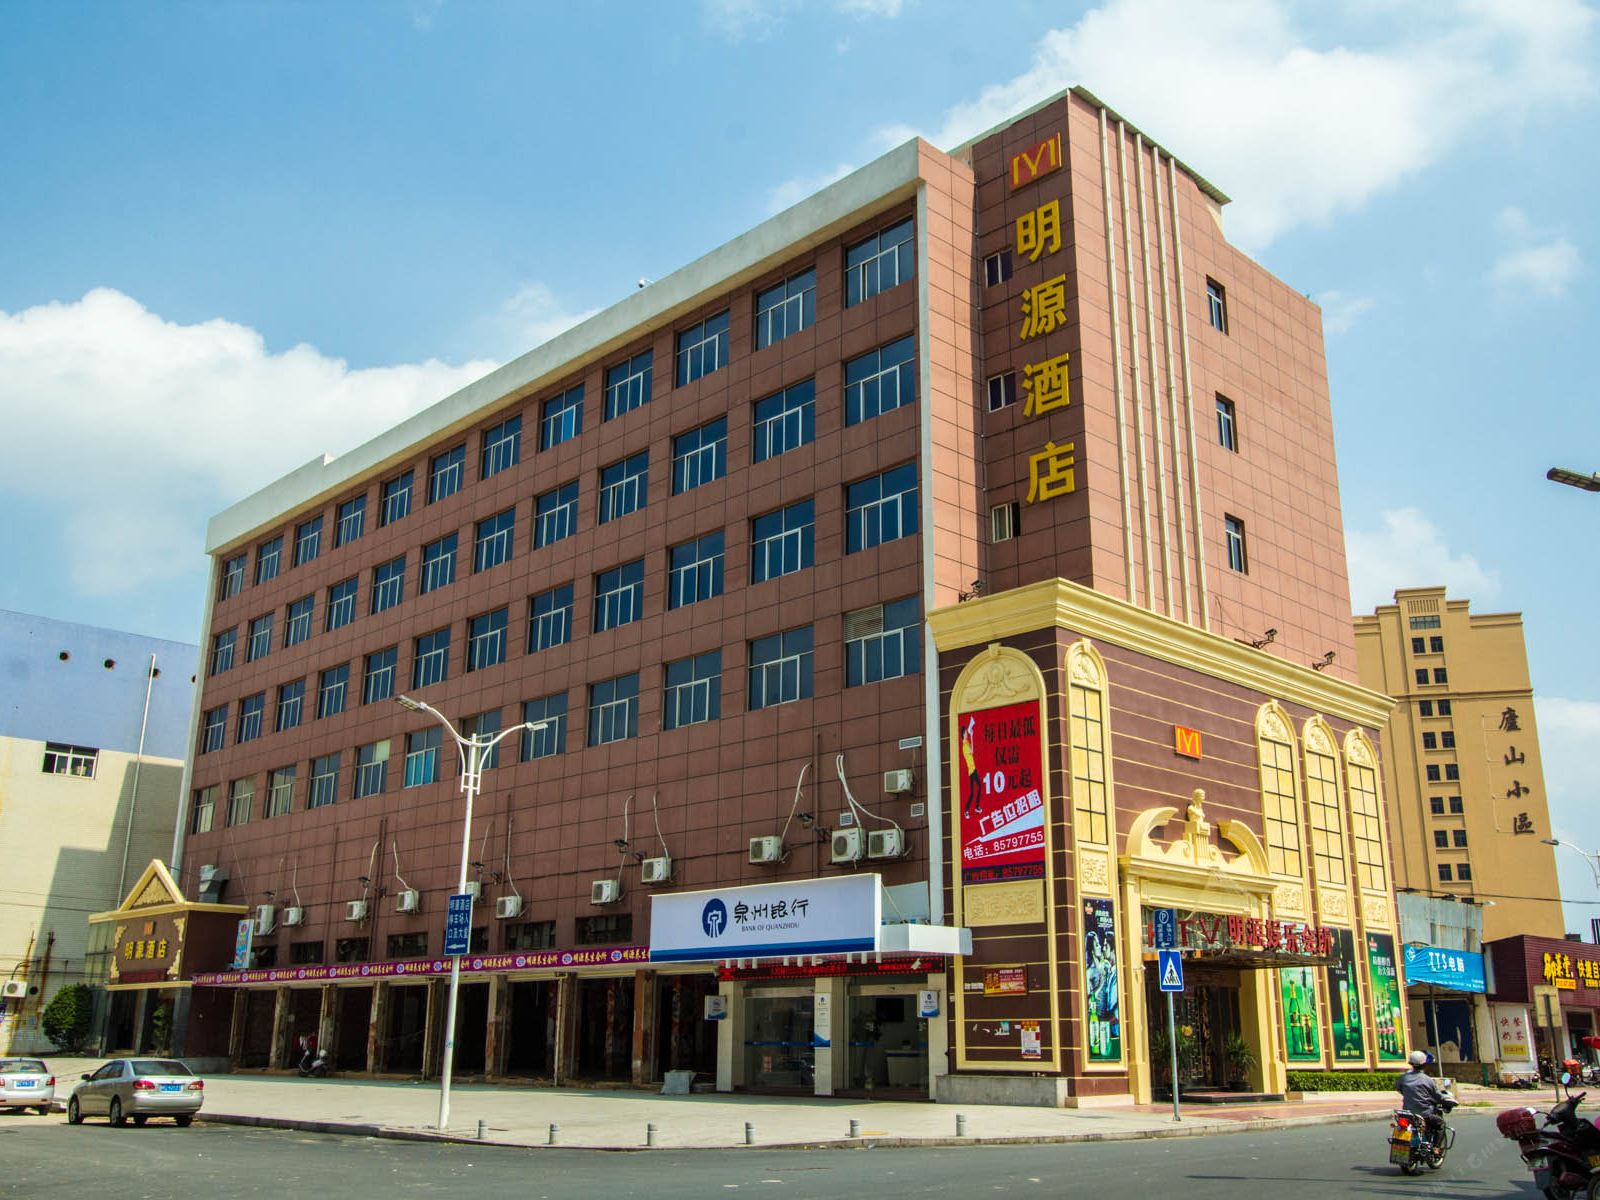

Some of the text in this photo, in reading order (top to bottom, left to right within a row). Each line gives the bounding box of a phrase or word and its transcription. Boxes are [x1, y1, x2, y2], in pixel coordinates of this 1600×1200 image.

[1015, 199, 1076, 504] 明源酒店
[983, 715, 1036, 743] 每日最低
[982, 769, 1032, 795] 10元起
[978, 789, 1042, 835] 广告位招租
[993, 830, 1043, 852] 85797755
[734, 898, 809, 924] 泉州银行
[765, 922, 800, 932] QUANZHOU
[1146, 917, 1222, 948] TV
[1227, 914, 1333, 955] 明源娱乐会所
[623, 948, 650, 961] 明源养生
[1577, 958, 1600, 979] 快捷自
